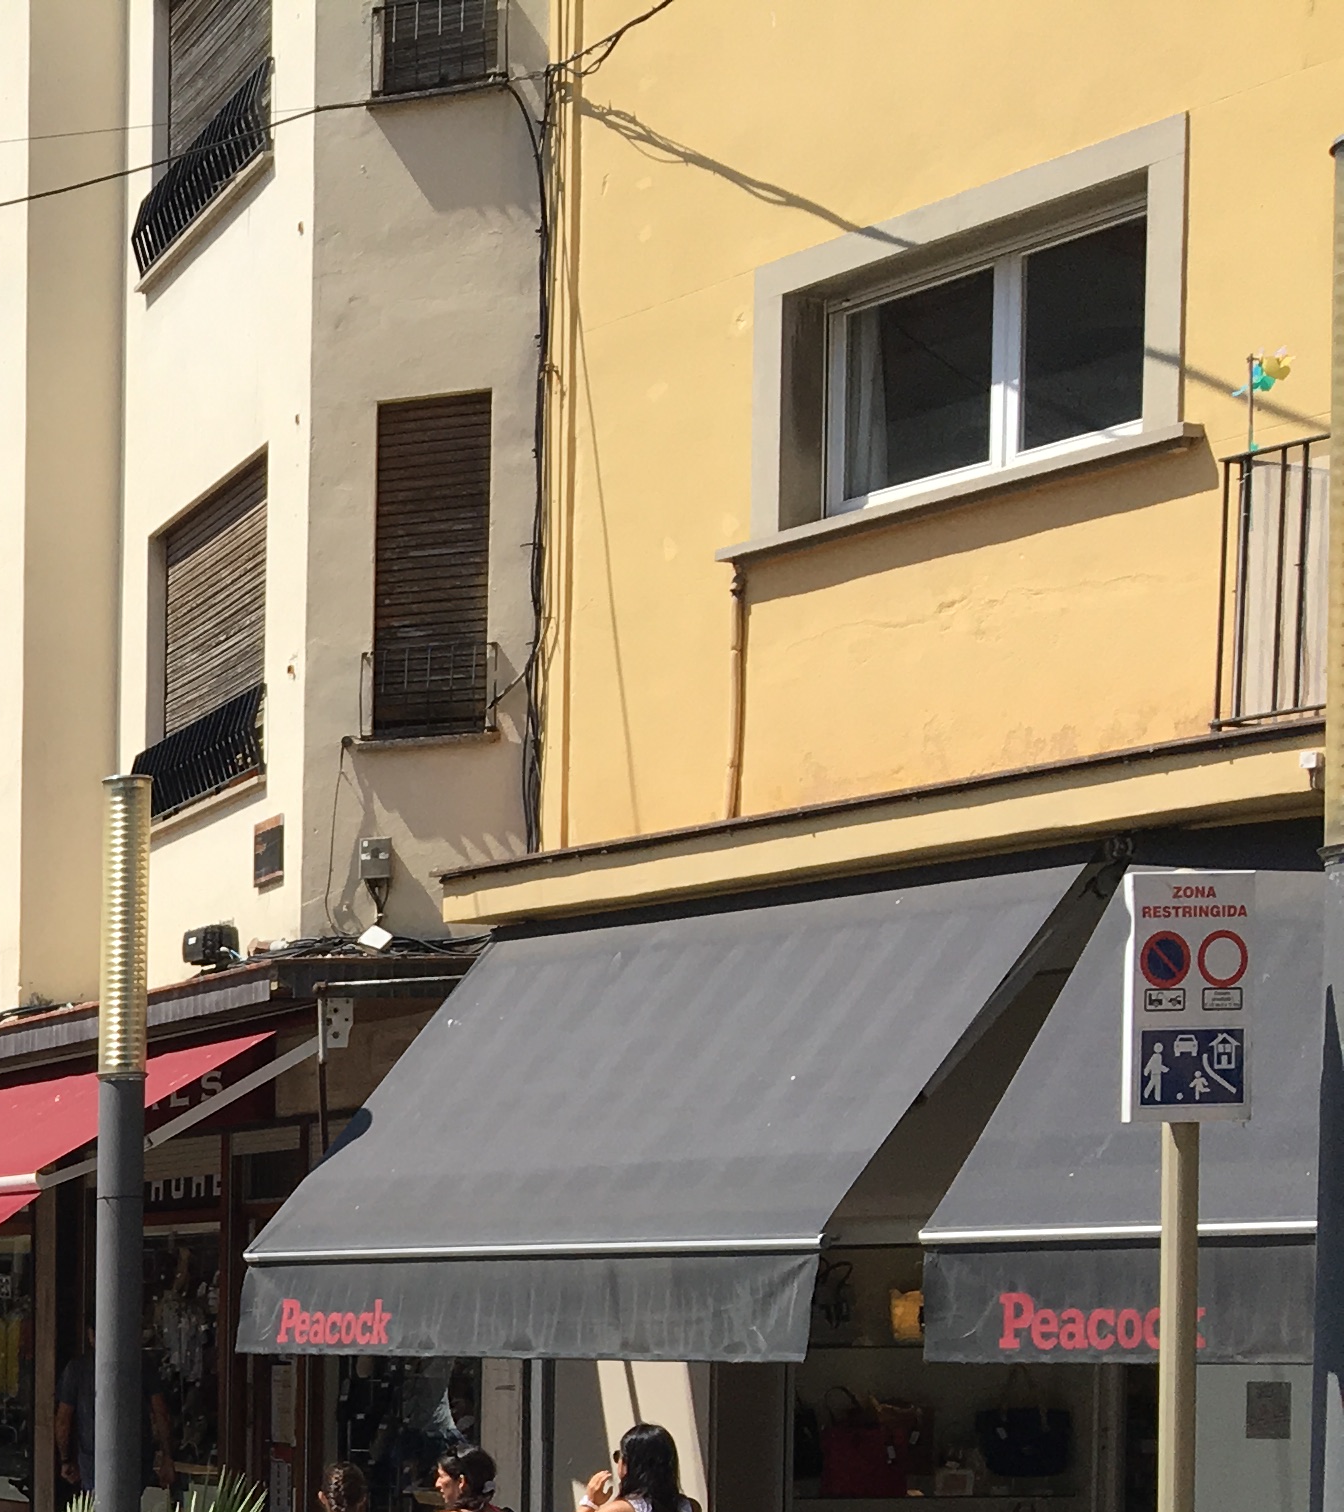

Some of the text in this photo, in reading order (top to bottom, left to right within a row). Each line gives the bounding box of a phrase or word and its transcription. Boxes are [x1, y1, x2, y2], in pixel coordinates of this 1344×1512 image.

[1172, 886, 1217, 899] ZONA
[1141, 904, 1249, 918] RESTRINGIDA
[275, 1298, 393, 1345] Peacock
[998, 1291, 1207, 1351] Peacoc
